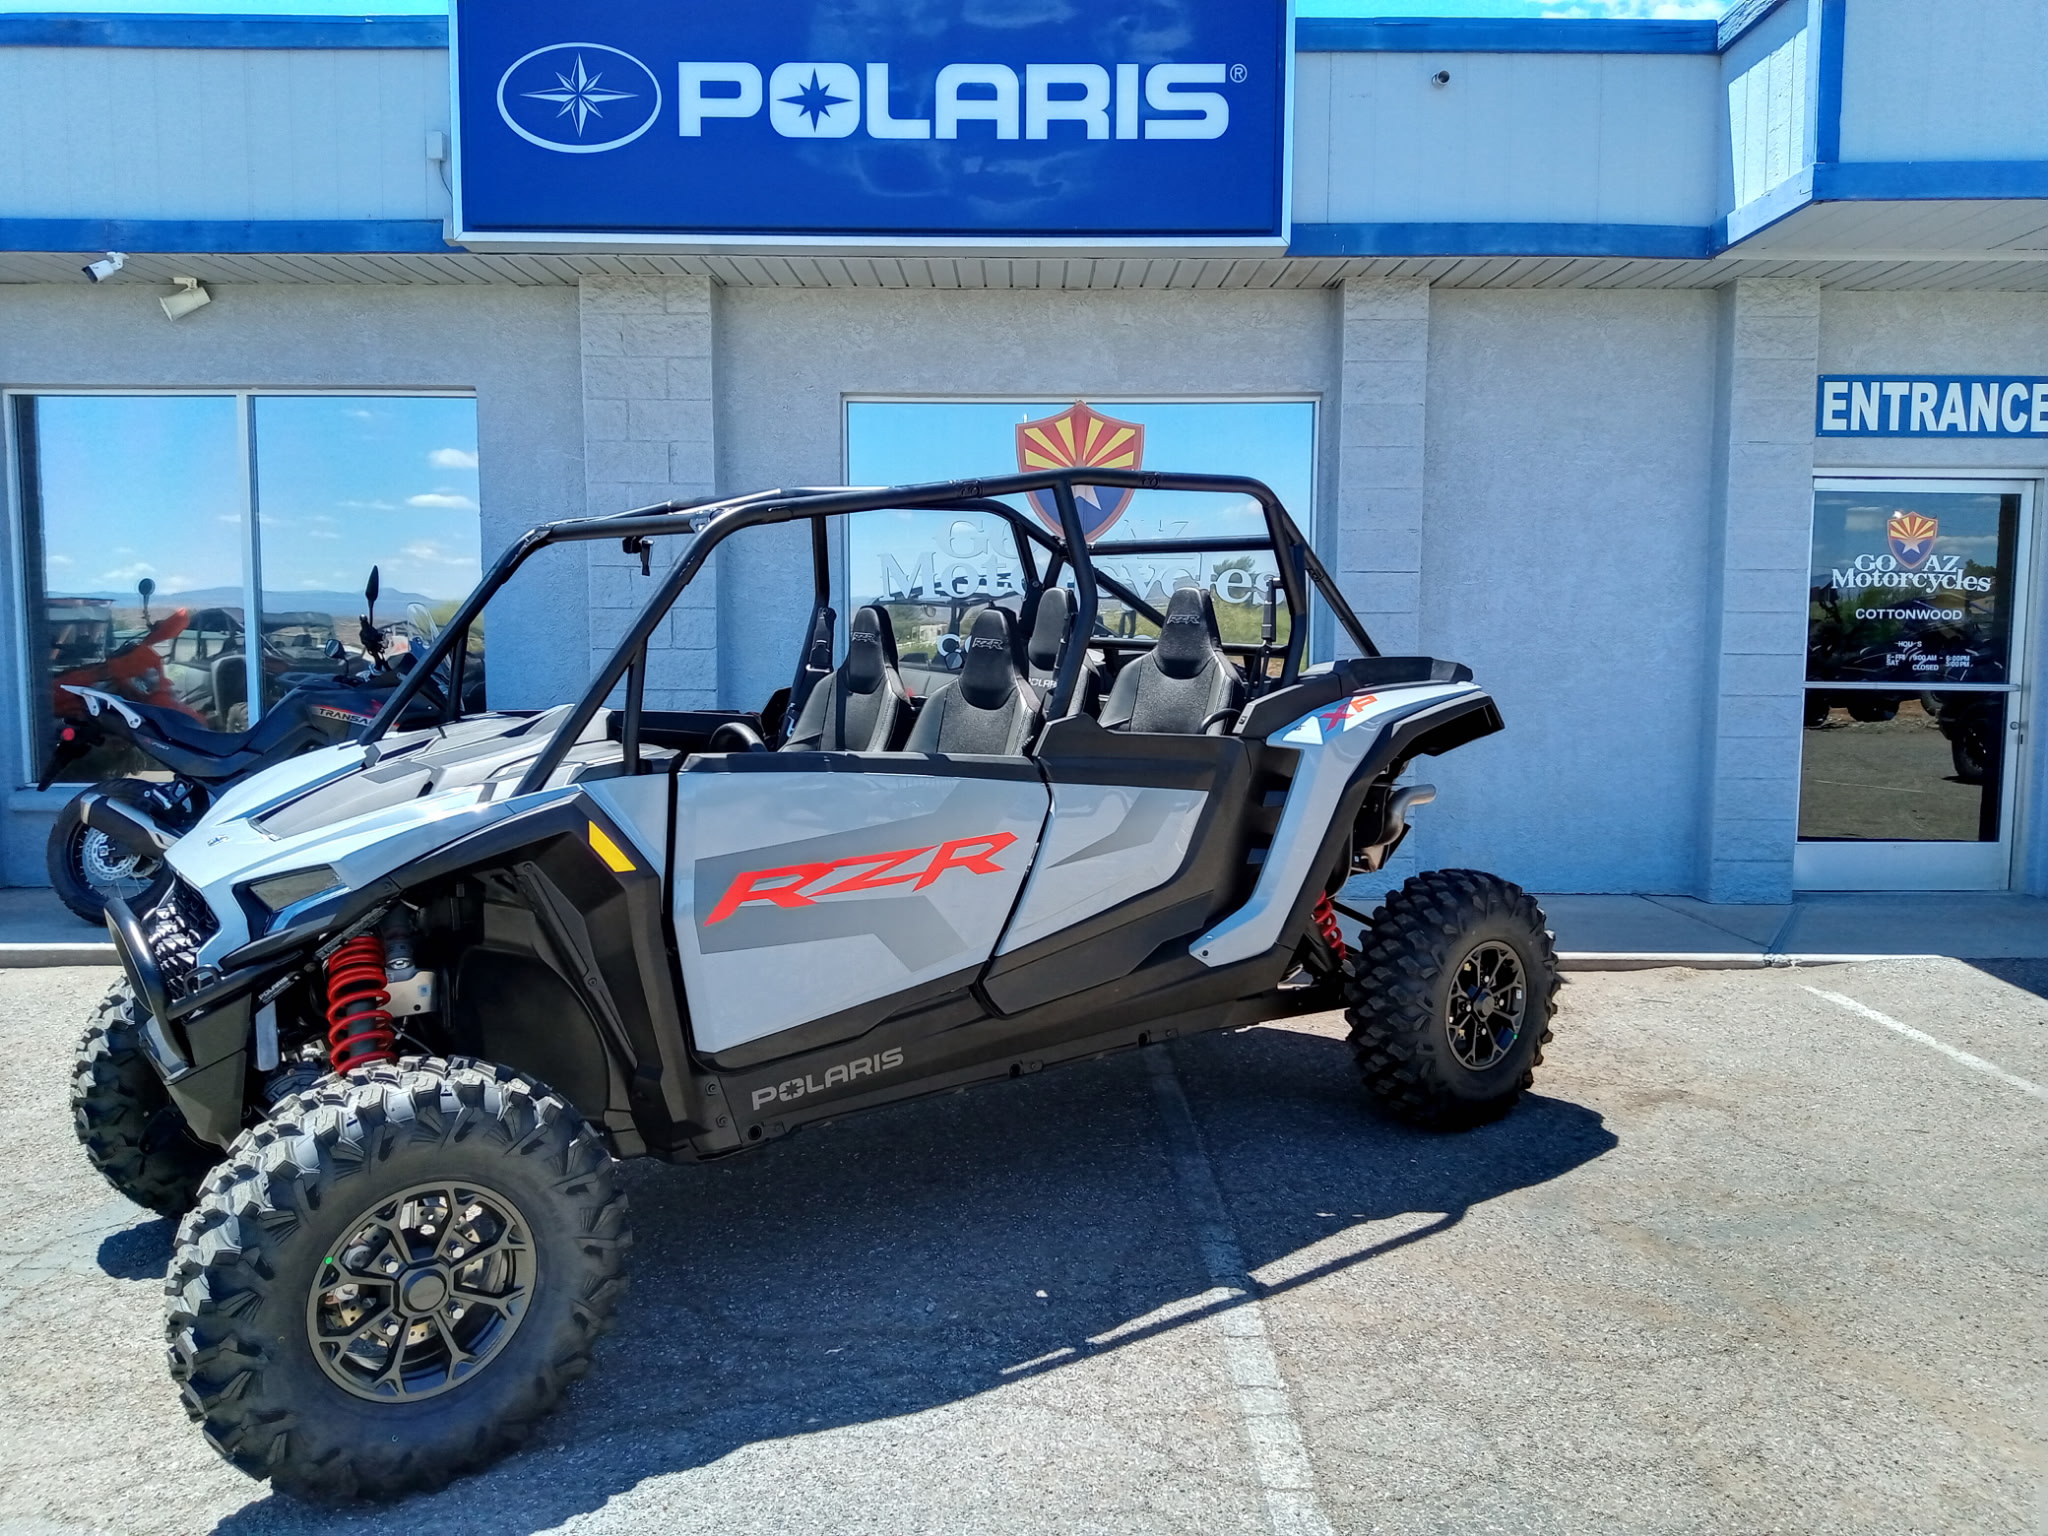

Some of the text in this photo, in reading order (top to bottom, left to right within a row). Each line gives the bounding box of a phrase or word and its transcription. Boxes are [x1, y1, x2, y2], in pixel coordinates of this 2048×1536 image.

[1822, 381, 2048, 433] ENTRANCE
[1831, 567, 1992, 593] Motorcycles
[1854, 554, 1961, 573] GO AZ
[1855, 608, 1963, 620] COTTONWOOD
[1321, 695, 1378, 732] XP
[704, 831, 1018, 927] RZR
[751, 1046, 904, 1111] POLARIS
